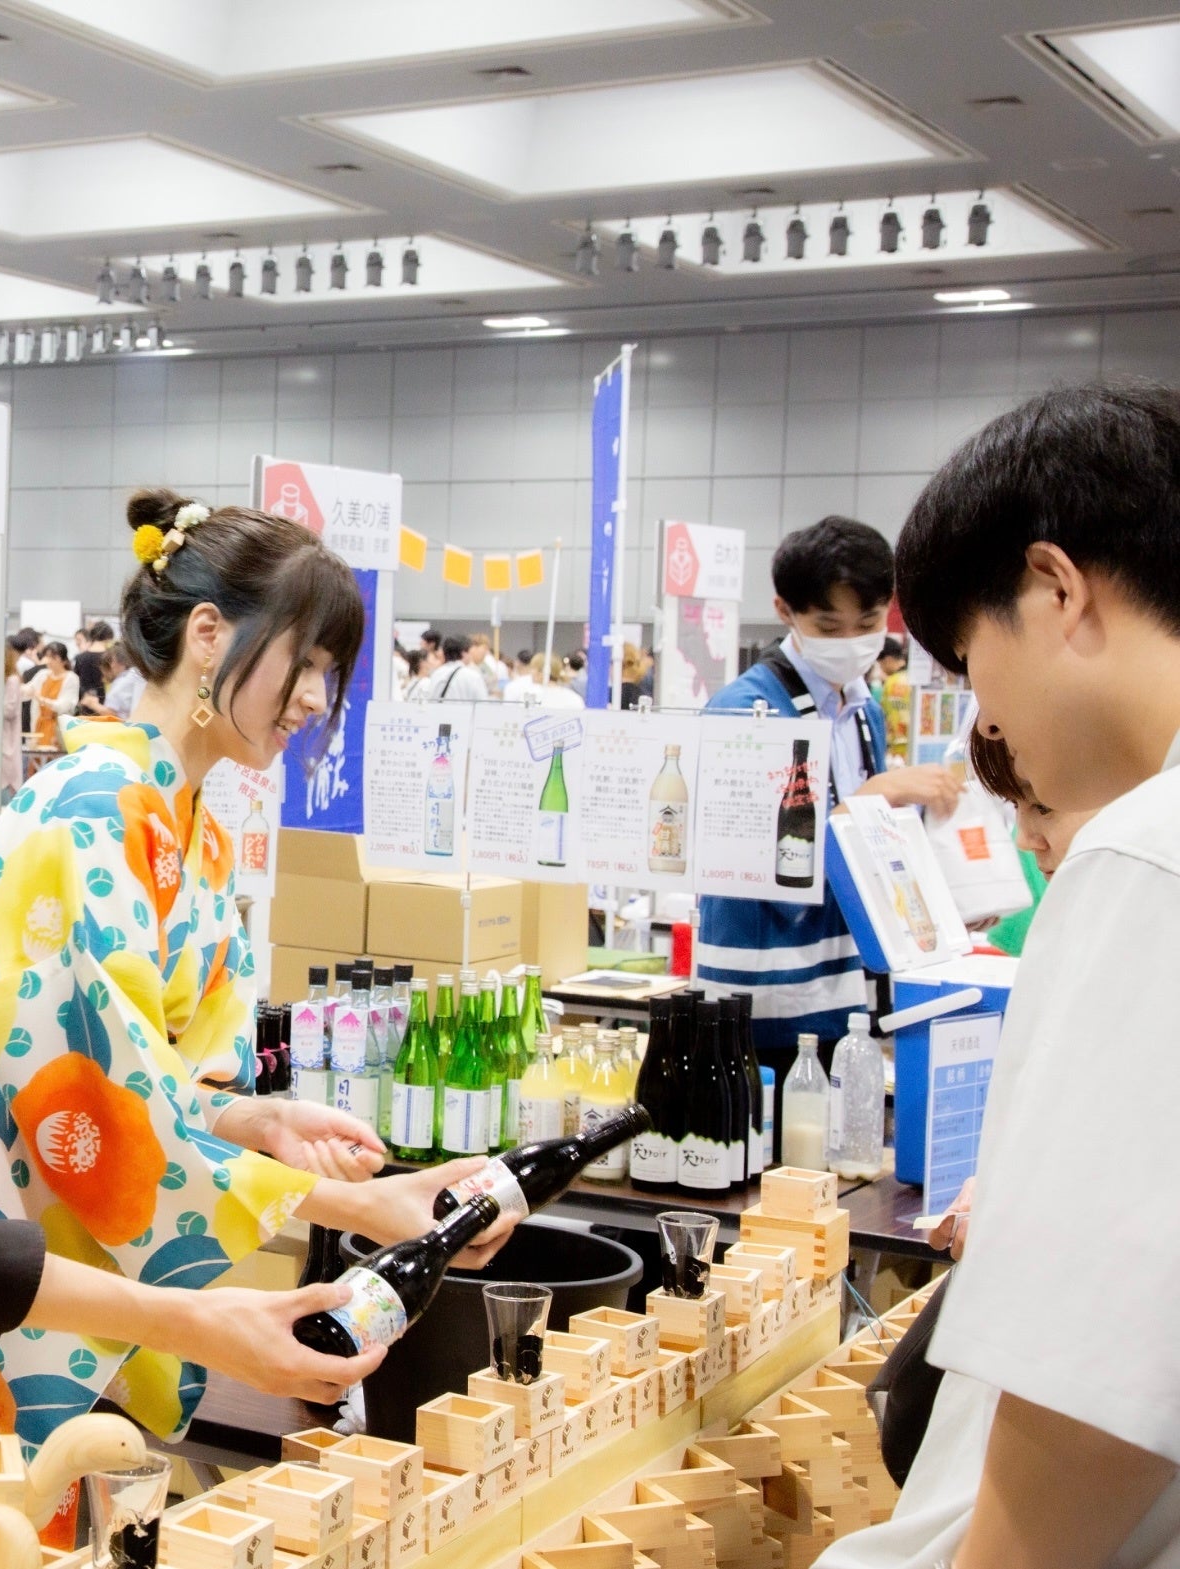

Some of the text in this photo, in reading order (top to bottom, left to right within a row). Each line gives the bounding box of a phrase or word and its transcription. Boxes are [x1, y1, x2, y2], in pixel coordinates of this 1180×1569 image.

[331, 498, 391, 532] 久美の浦
[635, 1349, 651, 1361] FOMUS
[540, 1410, 556, 1422] FOMUS
[492, 1442, 507, 1456] FOMUS
[526, 1464, 541, 1477] FOMUS
[398, 1486, 414, 1500] FOMUS
[473, 1500, 488, 1513] FOMUS
[439, 1520, 456, 1535] FOMUS
